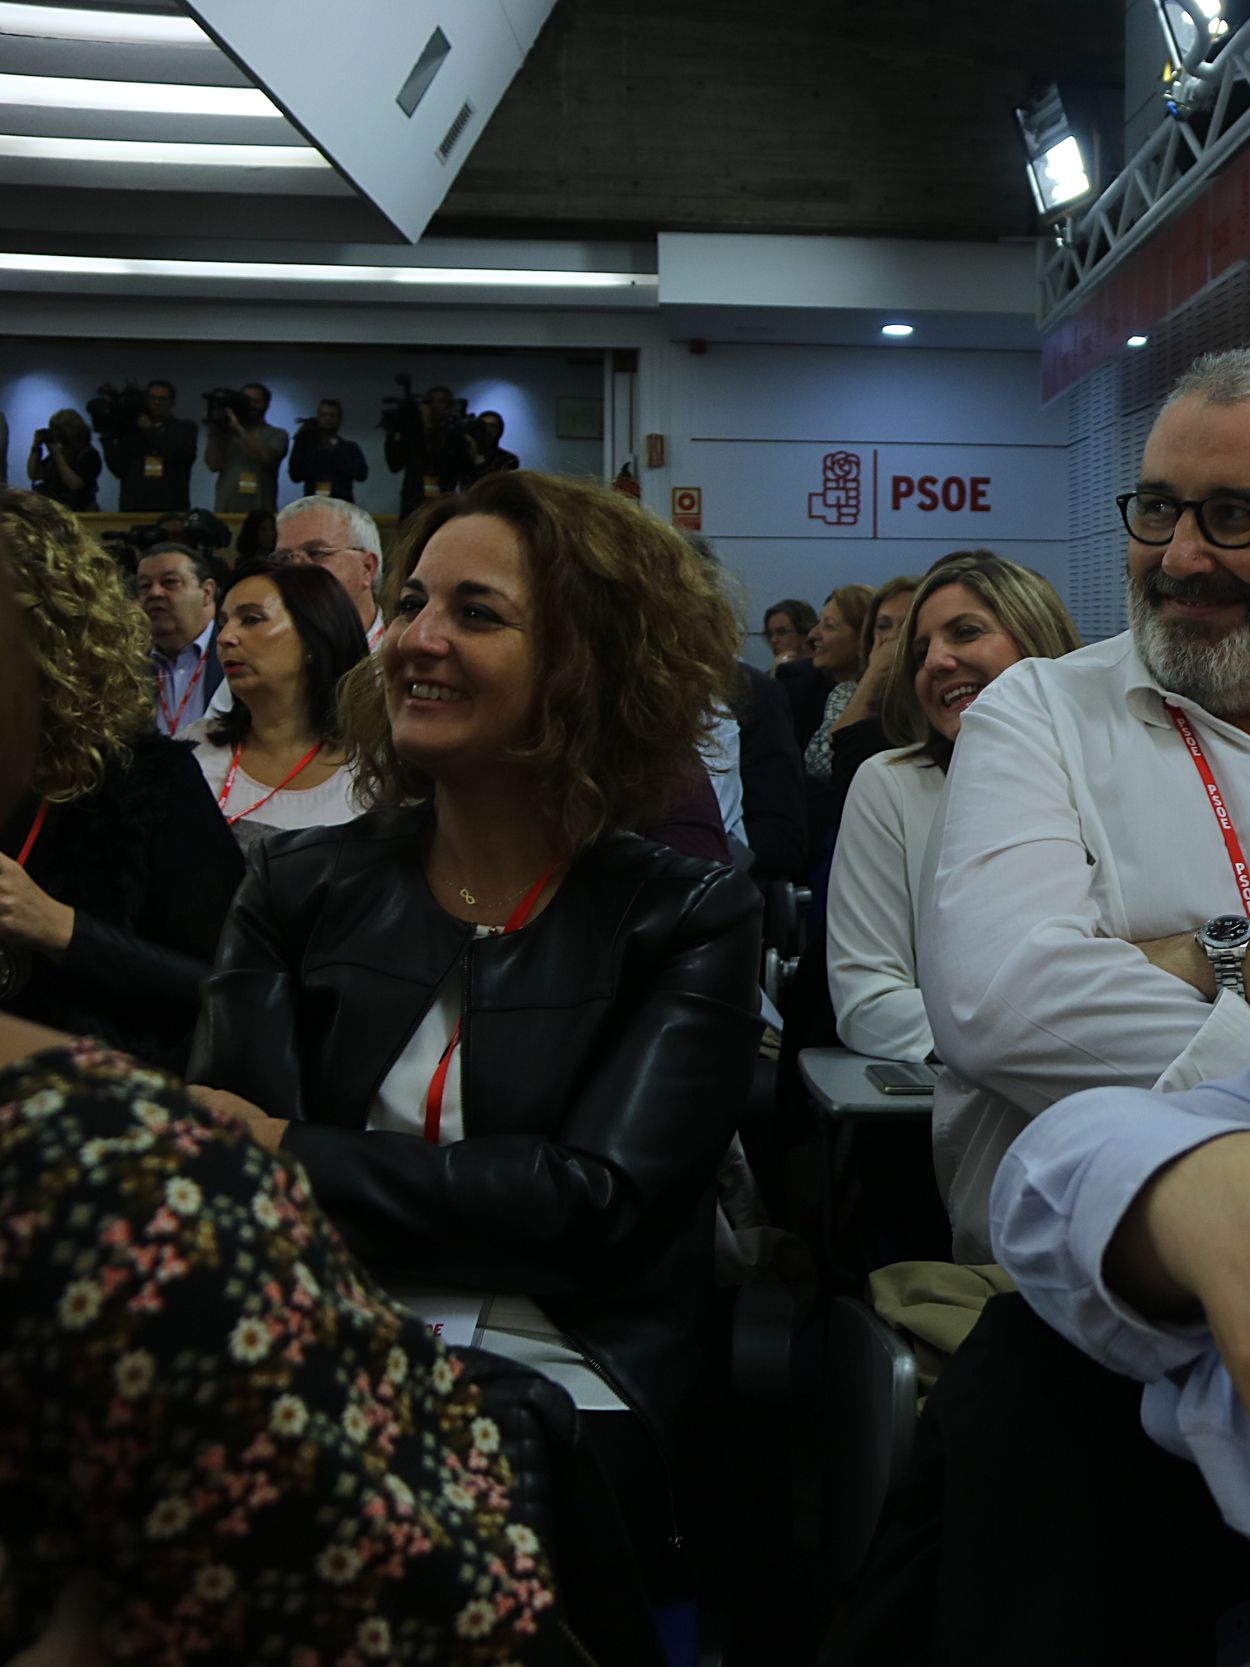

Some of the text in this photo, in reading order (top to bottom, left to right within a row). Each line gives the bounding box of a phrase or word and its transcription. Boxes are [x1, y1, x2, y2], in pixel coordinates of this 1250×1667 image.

[892, 475, 991, 512] PSOE
[1176, 717, 1201, 757] PSOE
[1207, 784, 1231, 830] PSOE
